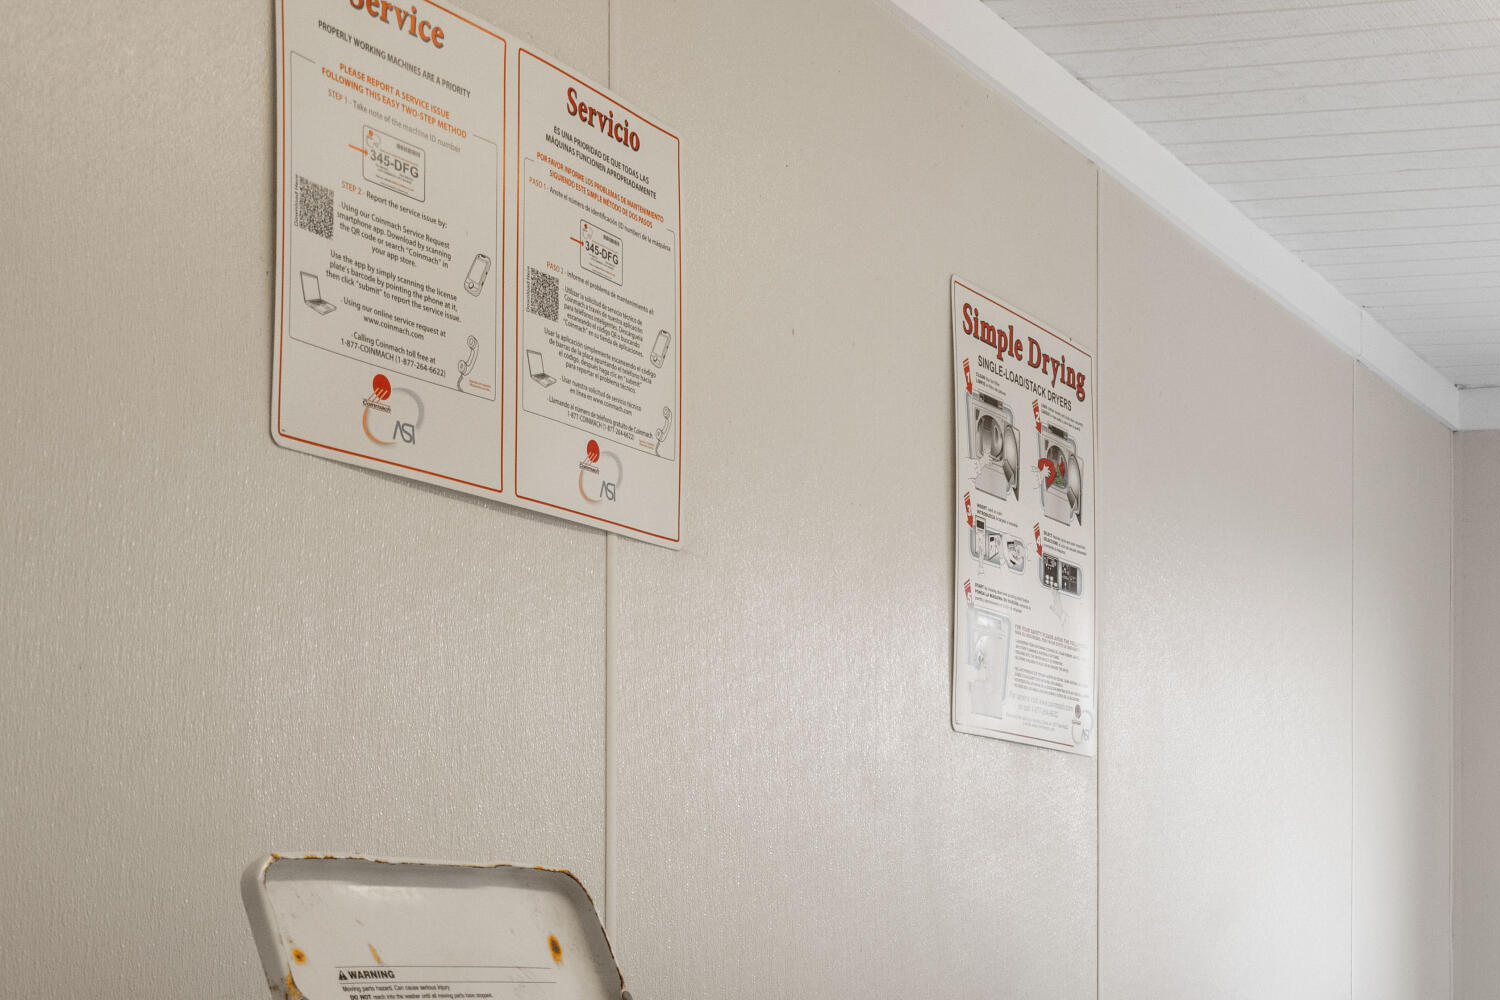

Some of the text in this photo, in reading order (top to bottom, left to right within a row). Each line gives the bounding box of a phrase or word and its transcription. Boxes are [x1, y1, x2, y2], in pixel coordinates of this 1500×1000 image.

[318, 21, 470, 98] PROPERLY WORKING MACHINES ARE A PRIORITY
[321, 67, 466, 138] FOLLOWING THIS EASY TWO-STEP METHOD
[339, 63, 450, 120] PLEASE REPORT A SERVICE ISSUE
[567, 87, 640, 152] Servicio
[370, 149, 418, 178] 345-DFG
[545, 134, 656, 200] MÁQUINAS FUNCIONEN APROPRIADAMENTE
[553, 126, 649, 184] ES UNA PRIORIDAD DE QUE TODAS LAS
[341, 180, 447, 229] STEP 2 Report the service issue by:
[341, 201, 449, 248] Using our Coinmach Service Request
[337, 212, 451, 259] smartphone app. Download by scanning
[339, 221, 349, 232] the
[351, 225, 360, 236] QR
[361, 231, 376, 242] code
[385, 240, 404, 252] search
[406, 246, 441, 265] "Coinmach"
[442, 259, 448, 269] in
[371, 246, 416, 267] your app store.
[585, 240, 618, 265] 345-DFG
[326, 269, 461, 322] then click "submit" to report the service issue.
[330, 250, 457, 301] Use the app by simply scanning the license
[330, 262, 349, 274] plate's
[350, 267, 375, 283] barcode
[376, 276, 384, 287] by
[385, 281, 411, 296] pointing
[412, 288, 422, 298] the
[423, 293, 442, 305] phone
[343, 297, 360, 311] Using
[362, 304, 372, 313] our
[373, 308, 392, 320] online
[394, 315, 414, 327] service
[416, 322, 438, 334] request
[363, 316, 424, 340] www.coinmach.com
[341, 338, 446, 378] 1-877-COINMACH (1-877-264-6622)
[353, 332, 374, 347] Calling
[375, 339, 405, 355] Coinmach
[406, 348, 416, 358] toll
[416, 351, 428, 362] free
[963, 303, 1085, 402] Simple Drying
[978, 355, 1046, 399] SINGLE-LOAD/STACK
[1048, 390, 1071, 411] DRYERS
[349, 970, 395, 980] WARNING
